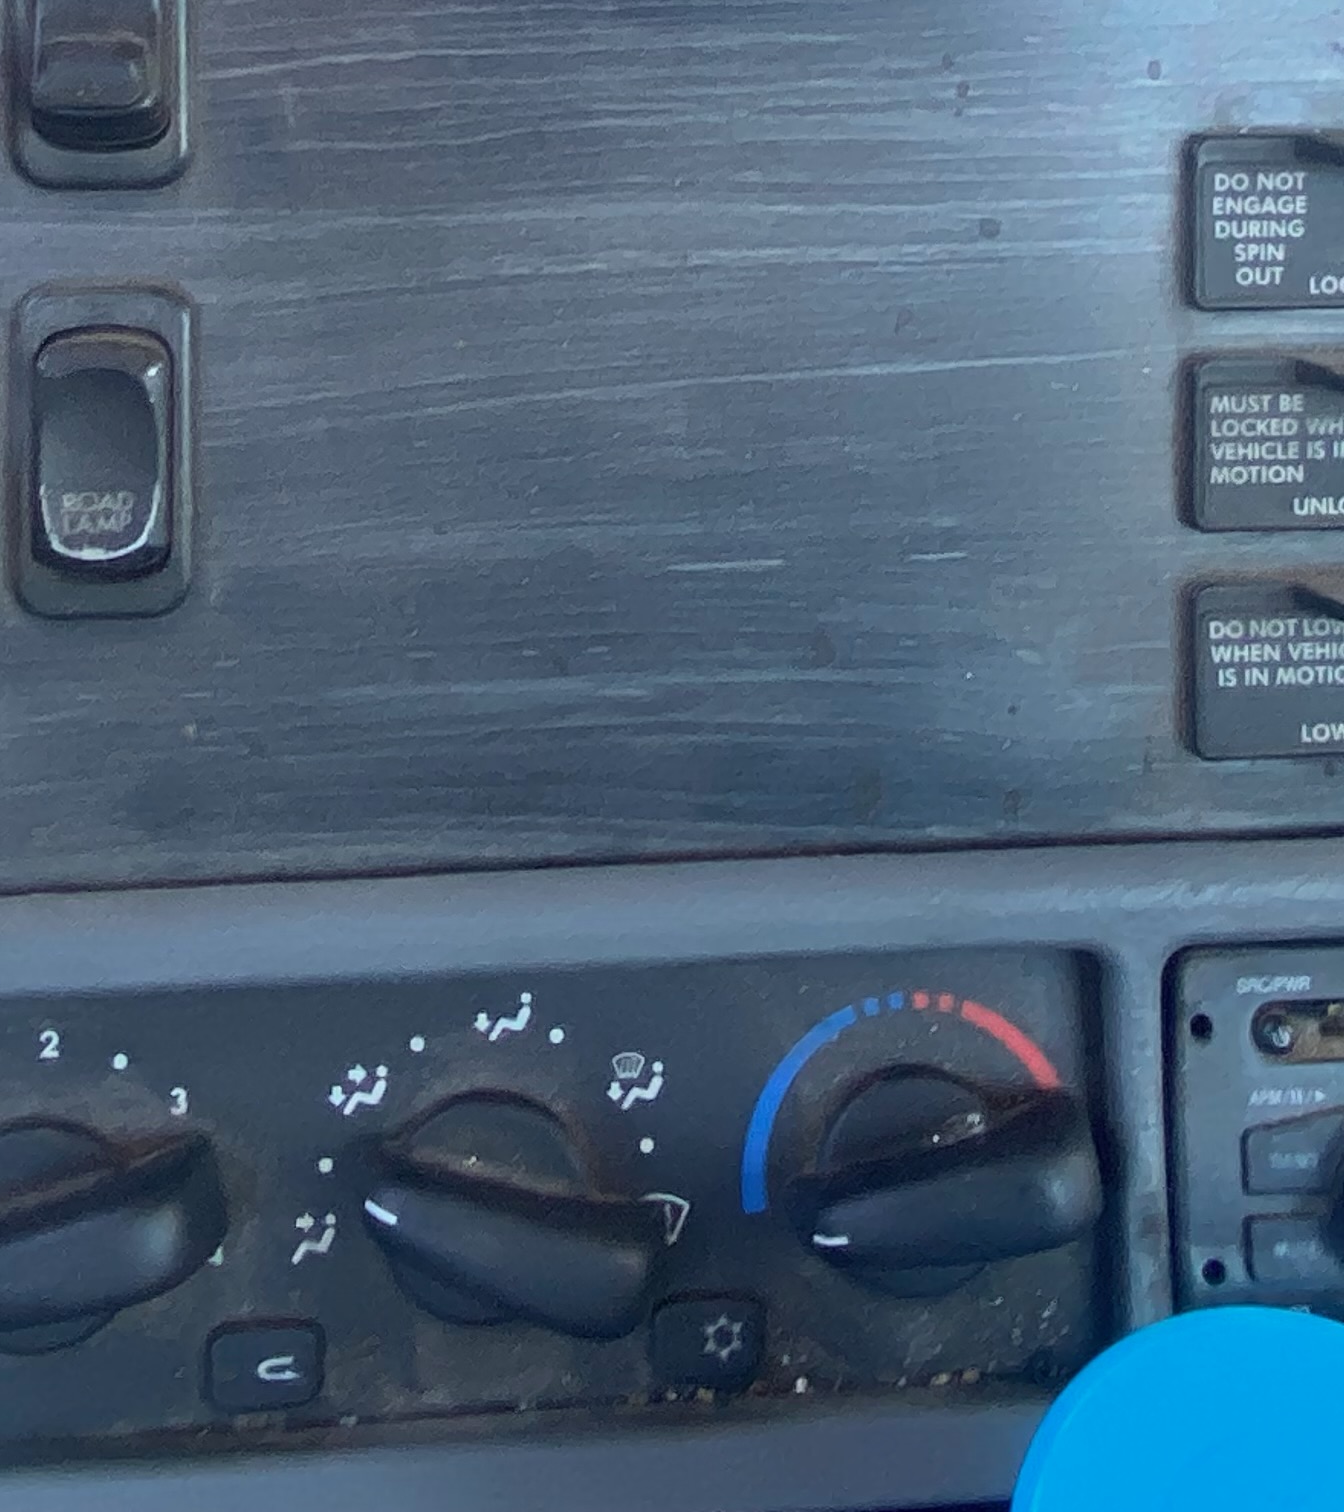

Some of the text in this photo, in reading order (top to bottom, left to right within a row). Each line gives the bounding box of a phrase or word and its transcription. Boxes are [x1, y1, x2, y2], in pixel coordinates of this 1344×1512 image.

[1214, 171, 1307, 192] DO NOT
[1212, 195, 1308, 216] ENGAGE
[1214, 219, 1306, 240] DURING
[1234, 243, 1285, 262] SPIN
[1235, 266, 1283, 286] OUT
[1210, 393, 1304, 413] MUST BE
[1211, 417, 1299, 437] LOCKED
[1210, 442, 1299, 461] VEHICLE
[1306, 441, 1326, 460] IS
[1209, 464, 1304, 485] MOTION
[1209, 620, 1243, 639] DO
[1255, 618, 1296, 638] NOT
[1211, 643, 1282, 663] WHEN
[1218, 668, 1236, 687] IS
[1245, 666, 1270, 686] IN
[39, 1029, 60, 1059] 2
[170, 1087, 189, 1116] 3
